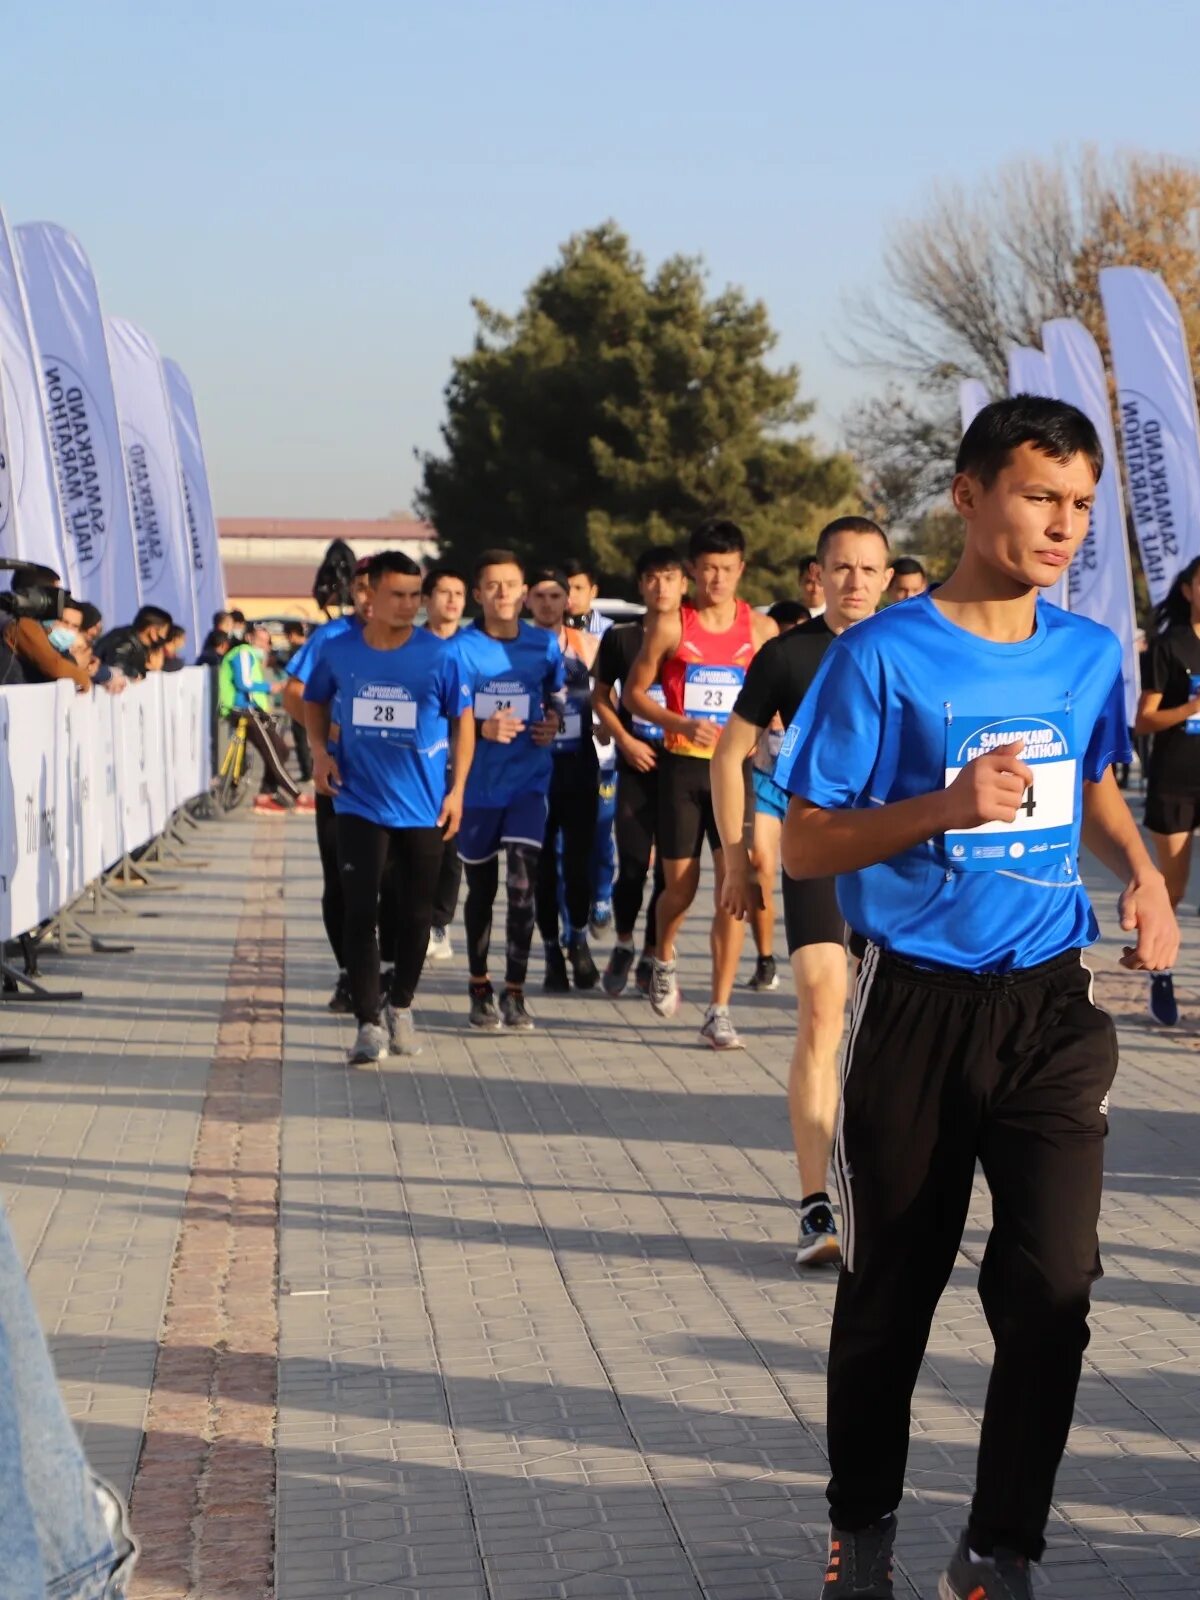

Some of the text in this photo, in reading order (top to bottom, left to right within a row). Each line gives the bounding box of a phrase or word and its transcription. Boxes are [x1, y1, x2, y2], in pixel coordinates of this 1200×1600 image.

[703, 690, 723, 706] 23
[373, 704, 394, 722] 28
[980, 729, 1054, 747] SAMARKAND
